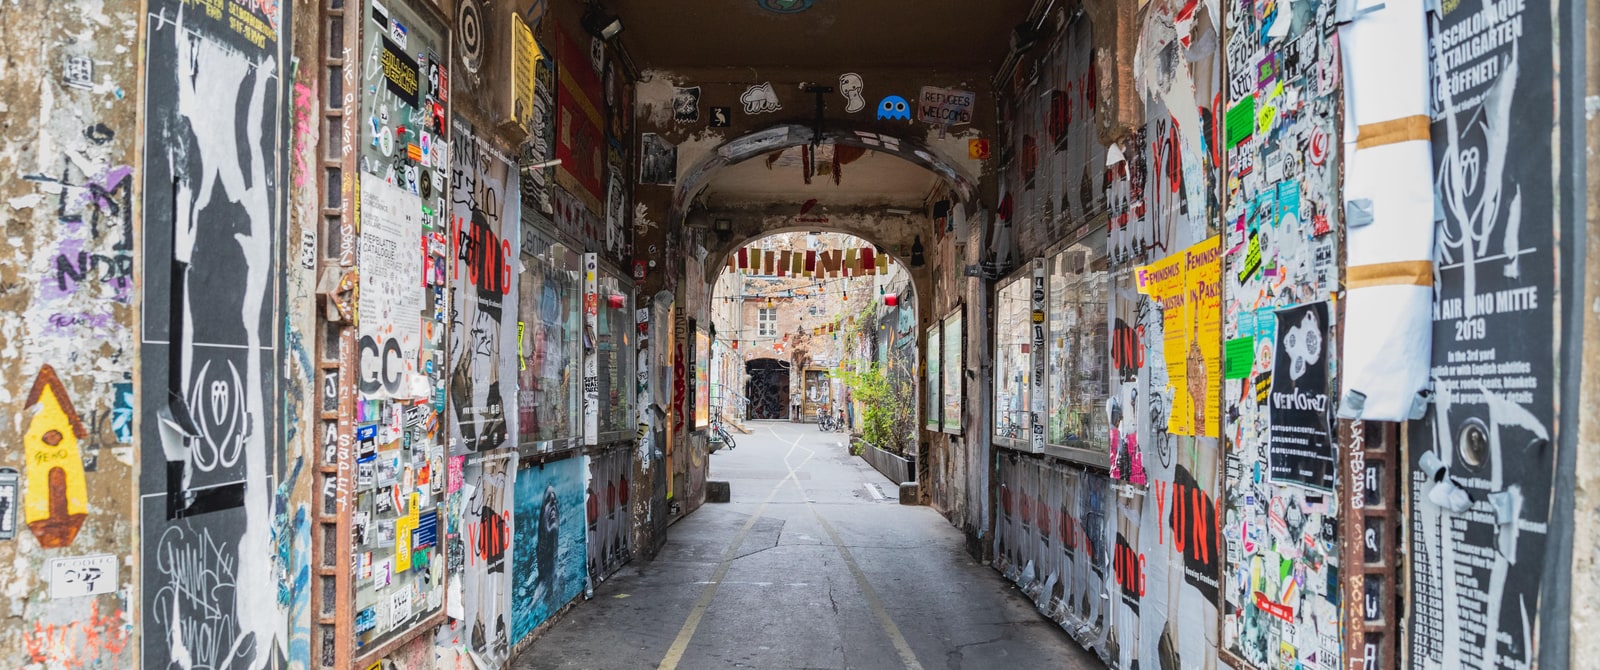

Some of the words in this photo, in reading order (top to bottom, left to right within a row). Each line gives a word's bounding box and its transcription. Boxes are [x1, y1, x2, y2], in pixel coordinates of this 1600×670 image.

[925, 91, 970, 107] REFUGEES
[922, 105, 970, 122] WELCOME
[1138, 262, 1180, 288] FEMINISMUS
[1442, 298, 1462, 320] AIR
[1496, 286, 1538, 314] MITTE
[1455, 318, 1487, 342] 2019
[1112, 325, 1145, 370] UNG
[1472, 363, 1497, 378] English
[1497, 361, 1531, 377] subtitles
[468, 509, 511, 567] YUNG
[1114, 542, 1146, 598] UNG
